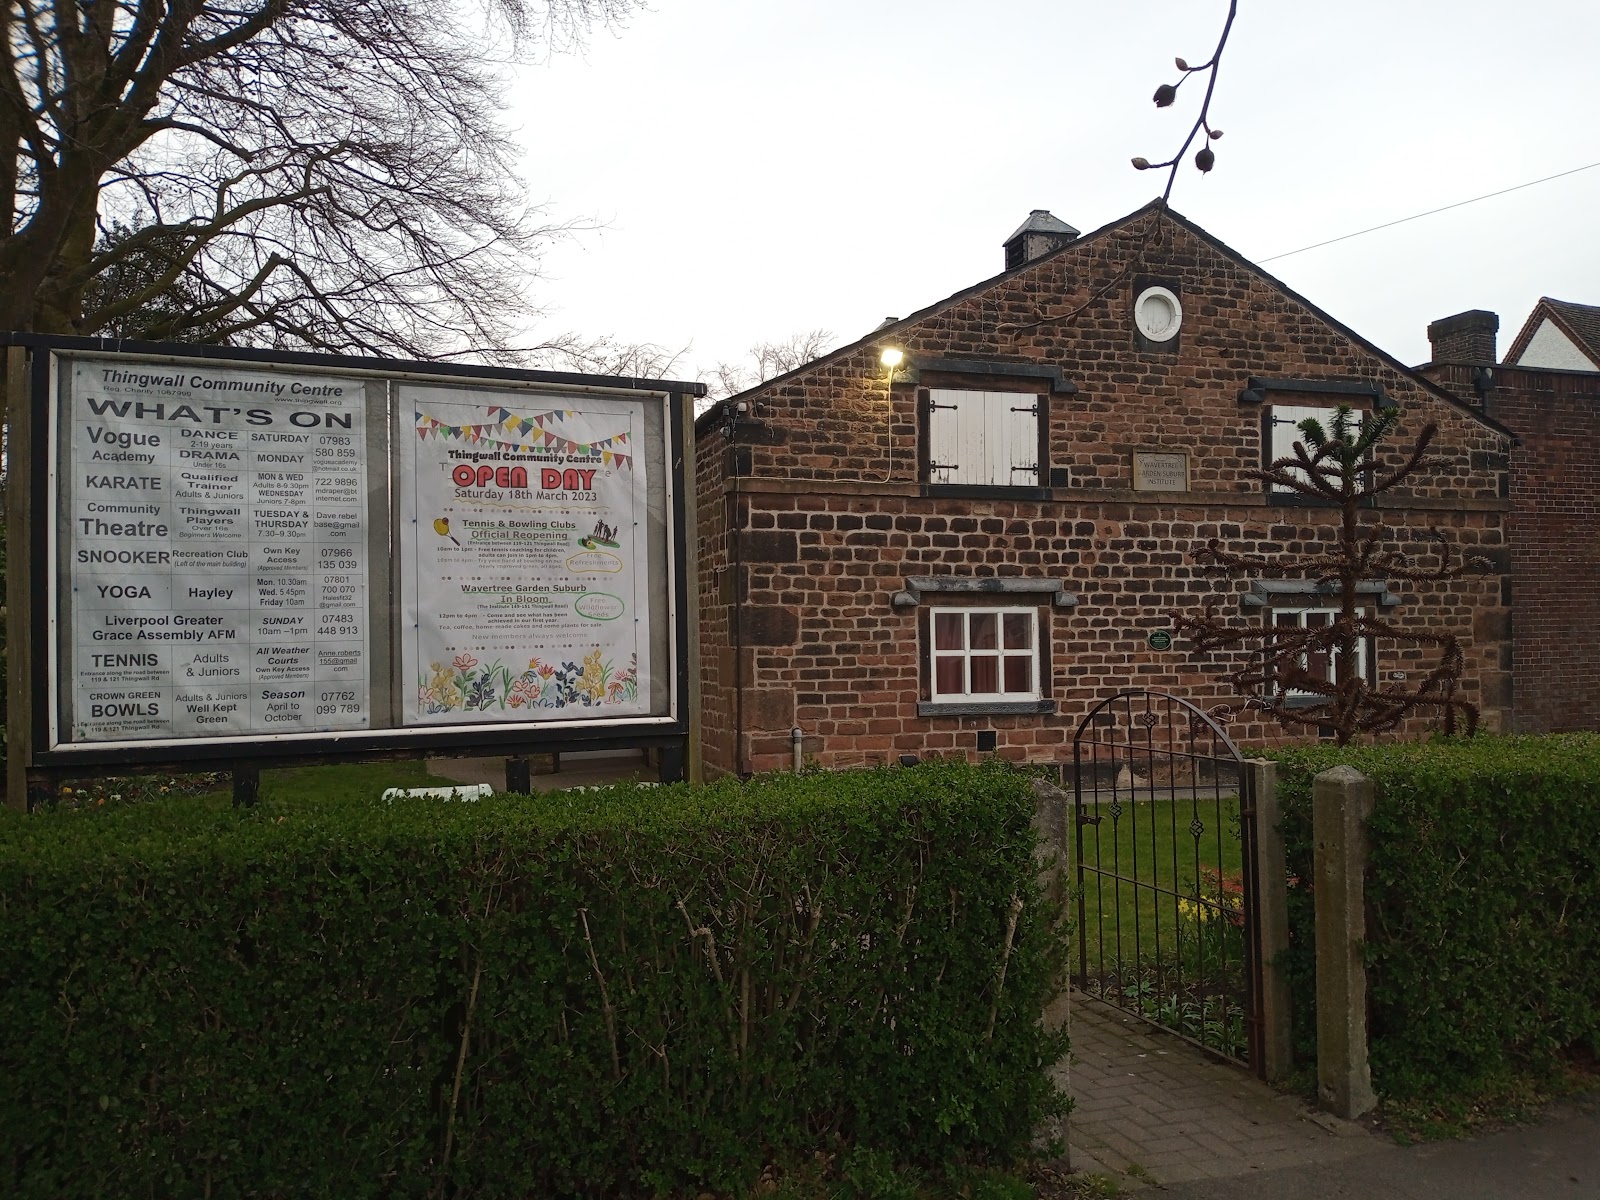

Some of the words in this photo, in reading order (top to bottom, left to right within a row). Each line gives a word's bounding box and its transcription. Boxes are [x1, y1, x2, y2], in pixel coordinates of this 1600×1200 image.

[102, 369, 185, 388] Thingwall
[190, 375, 285, 396] Community
[290, 382, 343, 397] Centre
[124, 387, 154, 395] Charity
[87, 398, 273, 426] WHAT'S
[289, 411, 351, 429] ON
[86, 426, 161, 449] Vogue
[181, 429, 239, 440] DANCE
[251, 433, 310, 443] SATURDAY
[319, 436, 351, 446] 07983
[211, 442, 233, 450] years
[92, 450, 156, 465] Academy
[180, 450, 240, 460] DRAMA
[315, 448, 334, 457] 580
[336, 448, 356, 458] 859
[448, 450, 500, 463] Thingwall
[502, 452, 564, 465] Community
[566, 455, 602, 464] Centre
[257, 454, 305, 463] MONDAY
[181, 472, 239, 482] Qualified
[258, 472, 276, 480] MON
[278, 473, 284, 481] &
[286, 473, 304, 481] WED
[452, 464, 528, 488] OPEN
[540, 468, 597, 490] DAY
[1162, 470, 1185, 478] SUBURB
[86, 475, 162, 490] KARATE
[187, 481, 233, 490] Trainer
[315, 477, 332, 486] 722
[334, 478, 358, 486] 9896
[1148, 478, 1176, 486] INSTITUTE
[175, 490, 202, 498] Adults
[315, 488, 358, 496] mdraper@bt
[455, 488, 504, 501] Saturday
[508, 490, 533, 499] 18th
[536, 491, 568, 500] March
[571, 492, 597, 501] 2023
[284, 498, 306, 506] 7-8pm
[87, 502, 161, 516] Community
[179, 507, 241, 516] Thingwall
[254, 510, 300, 518] TUESDAY
[302, 510, 309, 518] &
[186, 516, 234, 525] Players
[255, 520, 308, 528] THURSDAY
[462, 519, 495, 527] Tennis
[498, 519, 506, 527] &
[508, 520, 548, 530] Bowling
[79, 518, 168, 537] Theatre
[313, 521, 360, 530] base@gmail
[471, 530, 509, 539] Official
[513, 531, 568, 541] Reopening
[172, 549, 224, 558] Recreation
[226, 550, 249, 558] Club
[284, 547, 301, 556] Key
[321, 548, 353, 558] 07966
[77, 549, 171, 564] SNOOKER
[318, 560, 336, 569] 135
[338, 560, 357, 569] 039
[257, 578, 275, 586] Mon.
[277, 578, 308, 586] 10.30am
[324, 575, 350, 584] 07801
[97, 585, 152, 598] YOGA
[258, 588, 278, 596] Wed.
[279, 588, 306, 597] 5.45pm
[461, 584, 513, 592] Wavertree
[515, 584, 550, 592] Garden
[553, 584, 587, 592] Suburb
[188, 587, 234, 600] Hayley
[260, 598, 284, 607] Friday
[285, 598, 305, 606] 10am
[501, 595, 513, 603] In
[516, 595, 549, 603] Bloom
[105, 615, 169, 627] Liverpool
[173, 615, 224, 625] Greater
[262, 616, 304, 625] SUNDAY
[322, 614, 354, 623] 07483
[258, 627, 282, 635] 10am
[317, 626, 337, 635] 448
[339, 625, 358, 635] 913
[92, 630, 133, 640] Grace
[136, 629, 204, 642] Assembly
[207, 629, 236, 639] AFM
[256, 647, 269, 655] All
[271, 646, 310, 655] Weather
[91, 653, 159, 667] TENNIS
[193, 653, 230, 663] Adults
[186, 667, 195, 677] &
[198, 666, 240, 677] Juniors
[175, 694, 204, 702] Adults
[205, 693, 213, 701] &
[261, 690, 305, 699] Season
[321, 691, 355, 701] 07762
[91, 703, 159, 718] BOWLS
[186, 704, 210, 713] Well
[213, 703, 237, 713] Kept
[266, 702, 288, 712] April
[290, 702, 300, 710] to
[316, 705, 337, 714] 099
[340, 704, 360, 713] 789
[196, 716, 228, 724] Green
[264, 713, 303, 722] October
